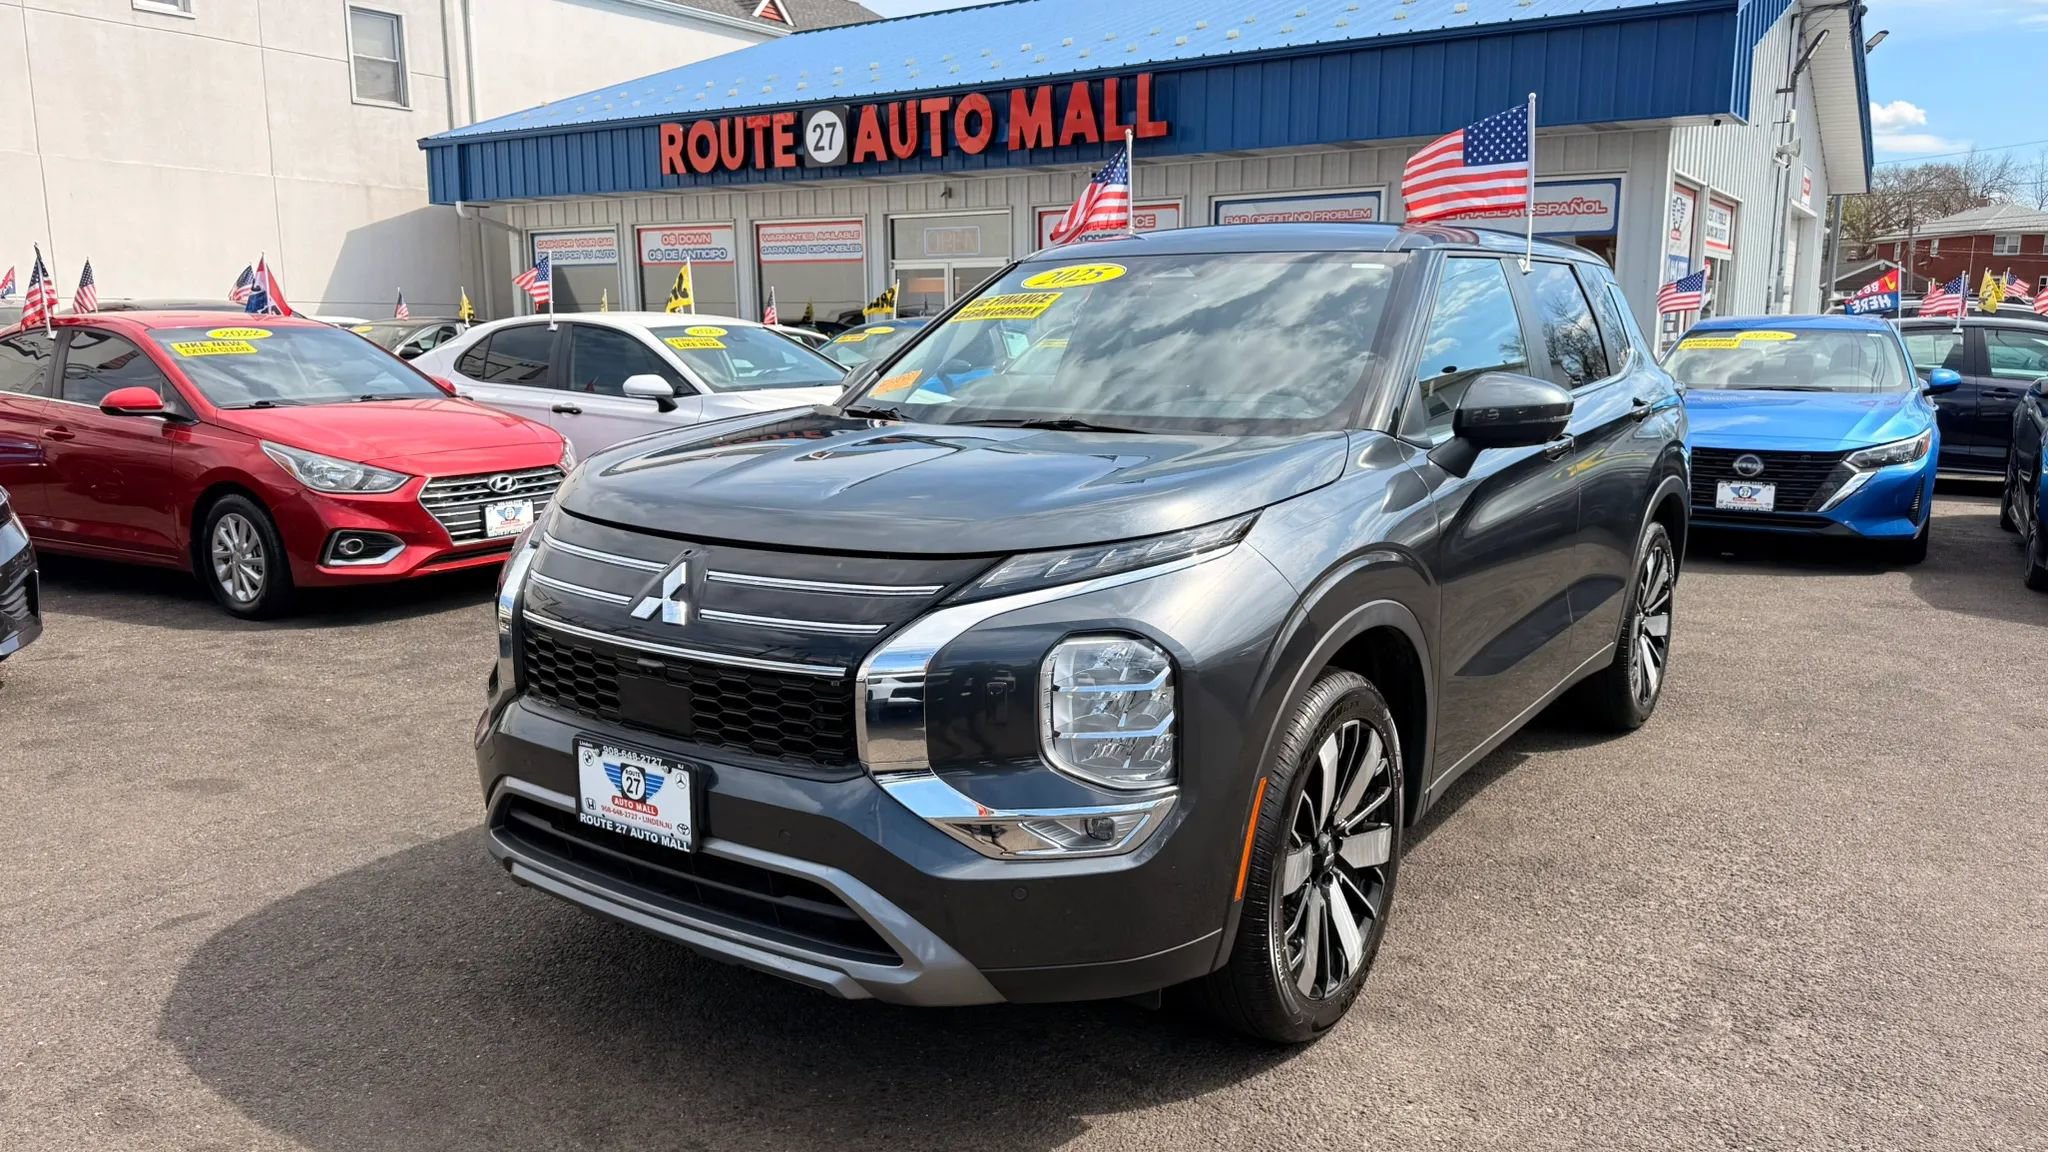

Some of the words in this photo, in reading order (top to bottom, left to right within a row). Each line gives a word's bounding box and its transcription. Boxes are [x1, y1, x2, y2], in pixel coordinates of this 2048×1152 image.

[660, 112, 797, 176] ROUTE
[812, 122, 837, 152] 27
[853, 92, 993, 163] AUTO
[1008, 72, 1167, 150] MALL
[1526, 197, 1608, 217] ESPAÑOL
[1224, 215, 1250, 224] BAD
[1293, 210, 1312, 222] NO
[1312, 208, 1372, 221] PROBLEM
[559, 239, 575, 248] FOR
[575, 238, 596, 248] YOUR
[597, 237, 614, 247] CAR
[678, 232, 712, 245] DOWN
[761, 232, 815, 243] WARRANTIES
[815, 230, 860, 241] AVAILABLE
[565, 250, 581, 260] POR
[581, 250, 593, 259] TU
[594, 249, 616, 259] AUTO
[664, 249, 679, 260] DE
[680, 248, 727, 260] ANTICIPO
[808, 243, 862, 254] DISPONIBLES
[1032, 266, 1115, 286] 2025
[990, 293, 1058, 307] FINANCE
[602, 745, 663, 767] 908-648-2727
[625, 769, 641, 778] ROUTE
[625, 776, 641, 796] 27
[614, 798, 634, 810] AUTO
[636, 801, 657, 815] MALL
[580, 812, 613, 831] ROUTE
[615, 823, 628, 836] 27
[630, 827, 659, 844] AUTO
[661, 835, 691, 853] MALL
